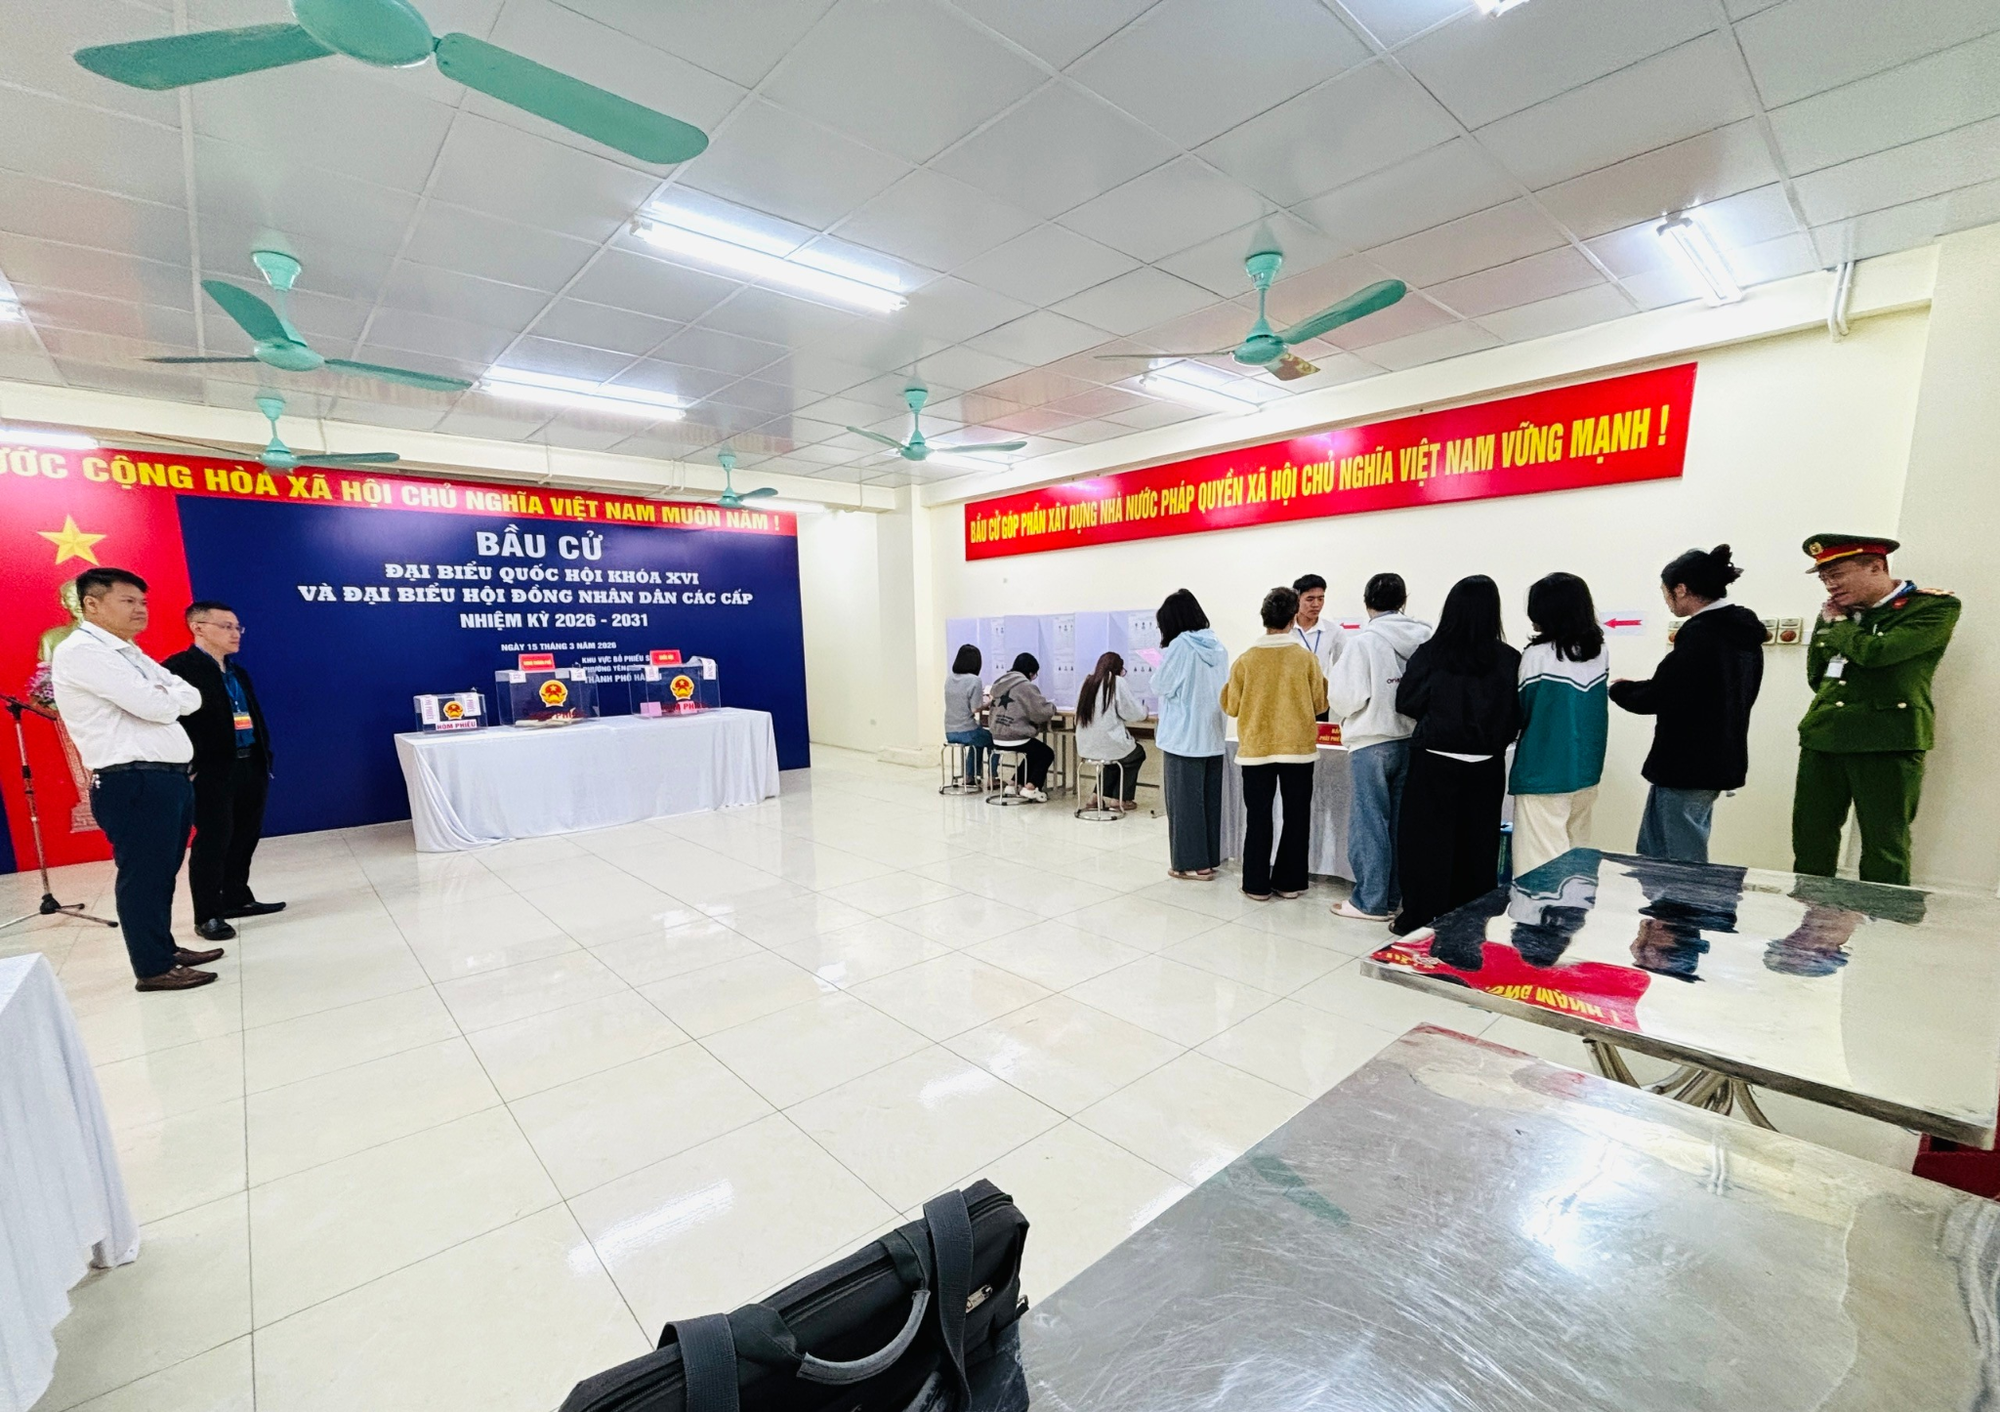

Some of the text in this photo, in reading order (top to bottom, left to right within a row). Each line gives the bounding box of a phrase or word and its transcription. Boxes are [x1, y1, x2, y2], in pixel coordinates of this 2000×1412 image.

[1002, 510, 1019, 540] GÓP
[1048, 502, 1067, 533] XÂY
[1069, 500, 1097, 534] DỰNG
[1100, 491, 1122, 525] NHÀ
[1125, 486, 1158, 521] NƯỚC
[1160, 480, 1195, 516] PHÁP
[1197, 467, 1244, 514] QUYỀN
[1246, 466, 1267, 504] XÃ
[1270, 461, 1298, 506] HỘI
[1301, 449, 1335, 496] CHỦ
[1340, 445, 1394, 489] NGHĨA
[1400, 437, 1441, 487] VIỆT
[1445, 434, 1495, 475] NAM
[1502, 420, 1564, 468] VỮNG
[1570, 406, 1651, 464] MẠNH
[1657, 404, 1670, 446] !
[82, 454, 193, 489] CỘNG
[204, 466, 279, 496] HÒA
[287, 470, 333, 500] XÃ
[341, 478, 392, 507] HỘI
[401, 482, 457, 508] CHỦ
[465, 490, 544, 515] NGHĨA
[549, 495, 598, 521] VIỆT
[605, 501, 655, 522] NAM
[661, 506, 721, 527] MUÔN
[726, 509, 768, 531] NĂM
[774, 515, 780, 531] !
[476, 523, 604, 561] BẦU CỬ
[384, 561, 699, 585] ĐẠI BIỂU QUỐC HỘI KHÓA XVI
[298, 582, 753, 605] VÀ ĐẠI BIỂU HỘI ĐỒNG NHÂN DÂN CÁC CẤP
[460, 610, 522, 631] NHIỆM
[527, 610, 549, 628] KỲ
[555, 613, 596, 628] 2026
[611, 613, 648, 628] 2031
[501, 641, 617, 652] NGÀY 15 THÁNG 3 NĂM 2026
[582, 656, 597, 664] KHU
[598, 655, 612, 664] VỰC
[624, 653, 644, 662] PHIẾU
[645, 654, 651, 662] S
[455, 721, 476, 729] PHIẾU
